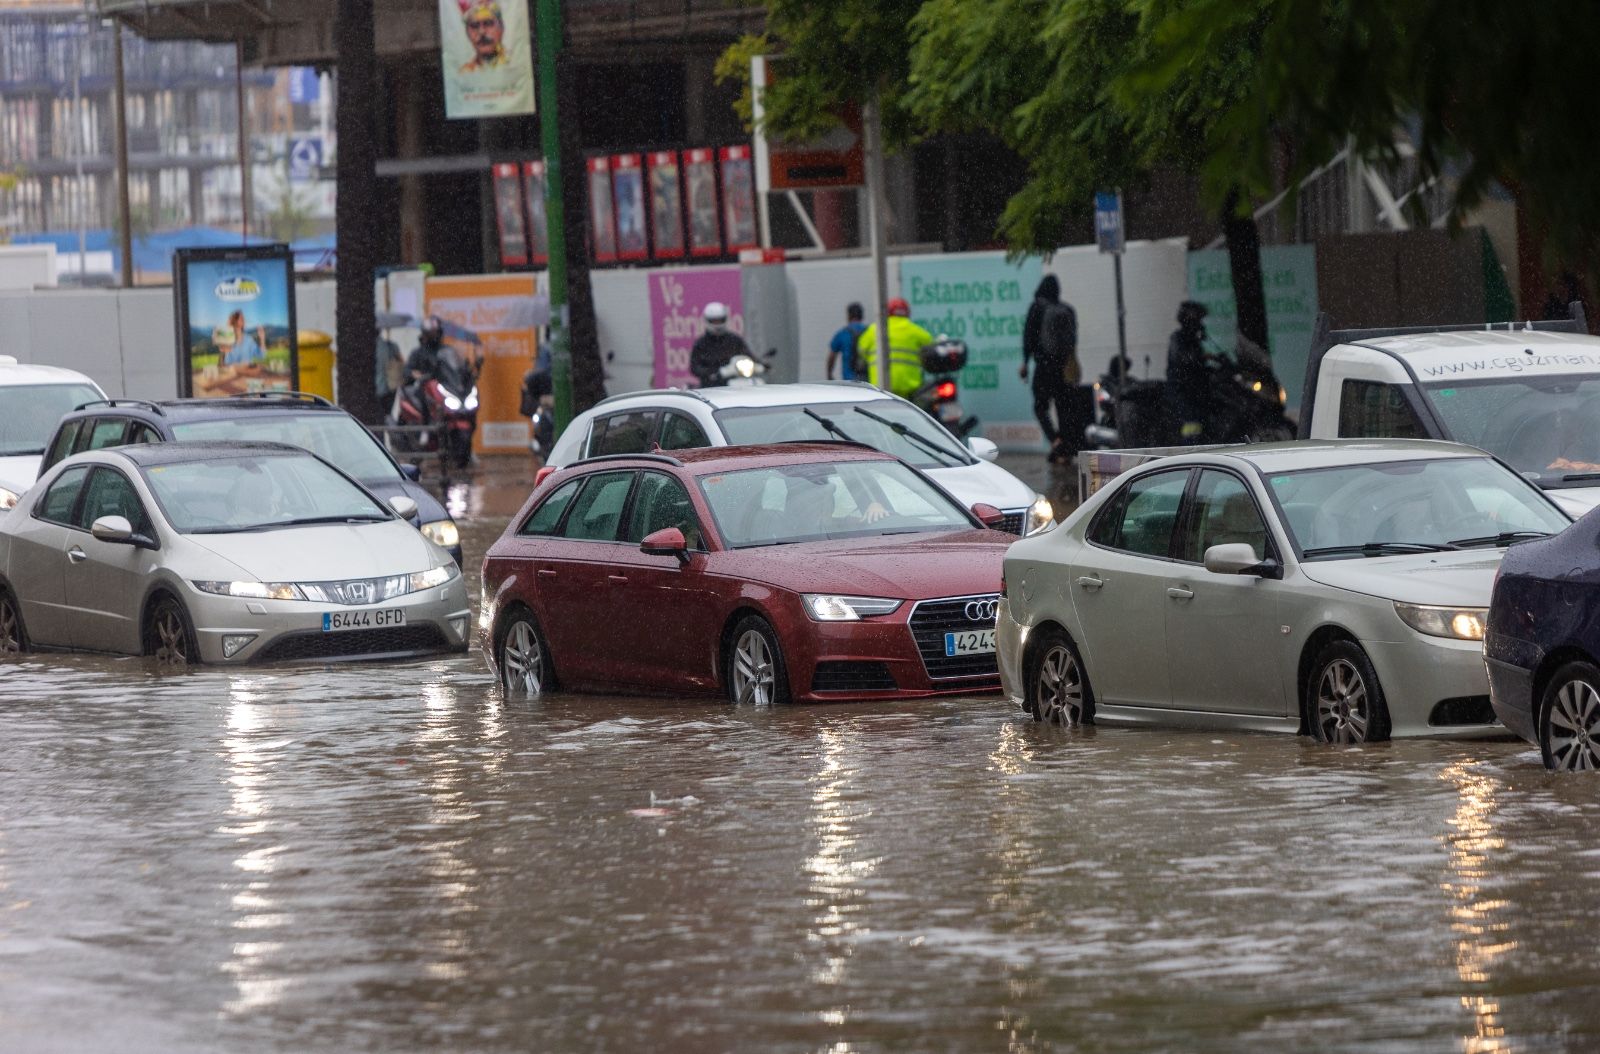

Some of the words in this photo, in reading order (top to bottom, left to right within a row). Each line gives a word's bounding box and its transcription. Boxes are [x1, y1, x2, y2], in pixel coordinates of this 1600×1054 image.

[660, 276, 683, 306] Ve
[911, 276, 993, 304] Estamos
[997, 280, 1020, 301] en
[333, 612, 370, 628] 6444
[376, 609, 403, 625] GFD
